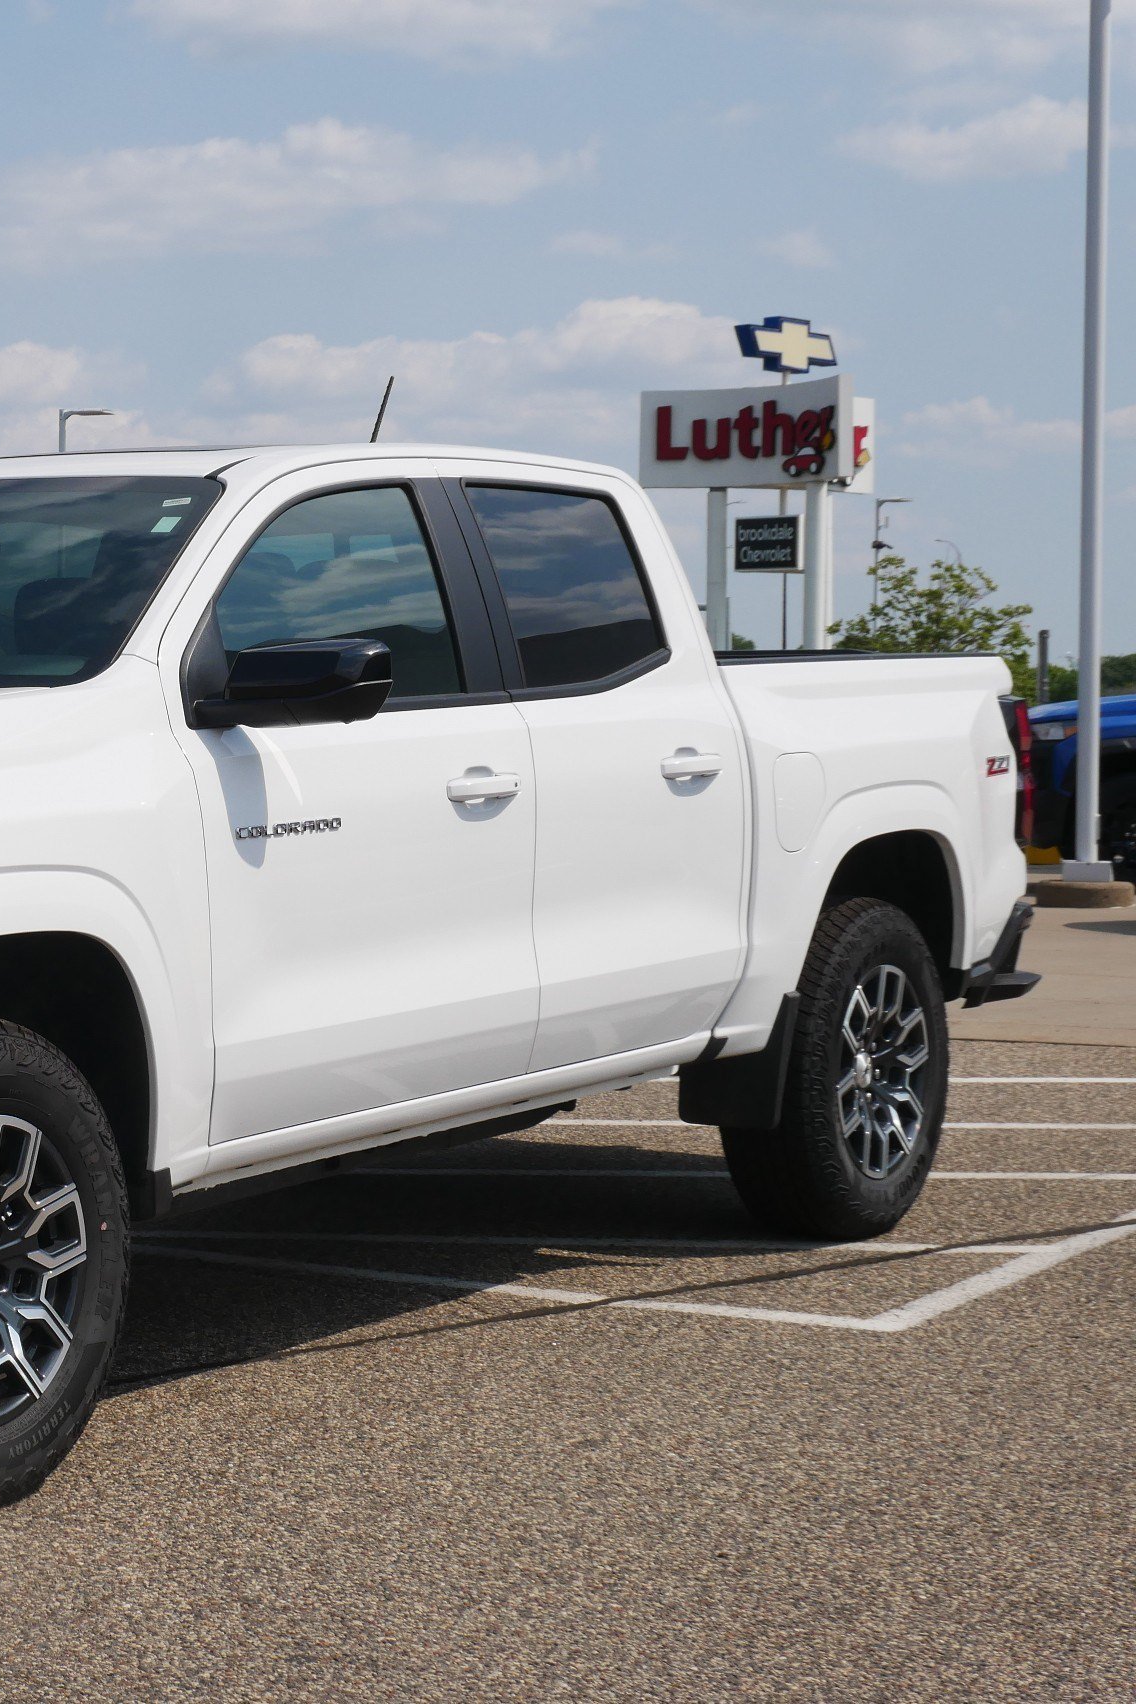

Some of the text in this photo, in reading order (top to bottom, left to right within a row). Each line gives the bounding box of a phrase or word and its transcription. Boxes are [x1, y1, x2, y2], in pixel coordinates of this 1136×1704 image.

[656, 400, 834, 460] Luther
[737, 523, 794, 541] brookdale
[740, 545, 792, 562] Chevrolet
[986, 755, 1010, 777] Z71
[235, 818, 342, 840] COLORADO
[67, 1113, 116, 1323] WRANGLER
[9, 1401, 72, 1460] TERRITORY
